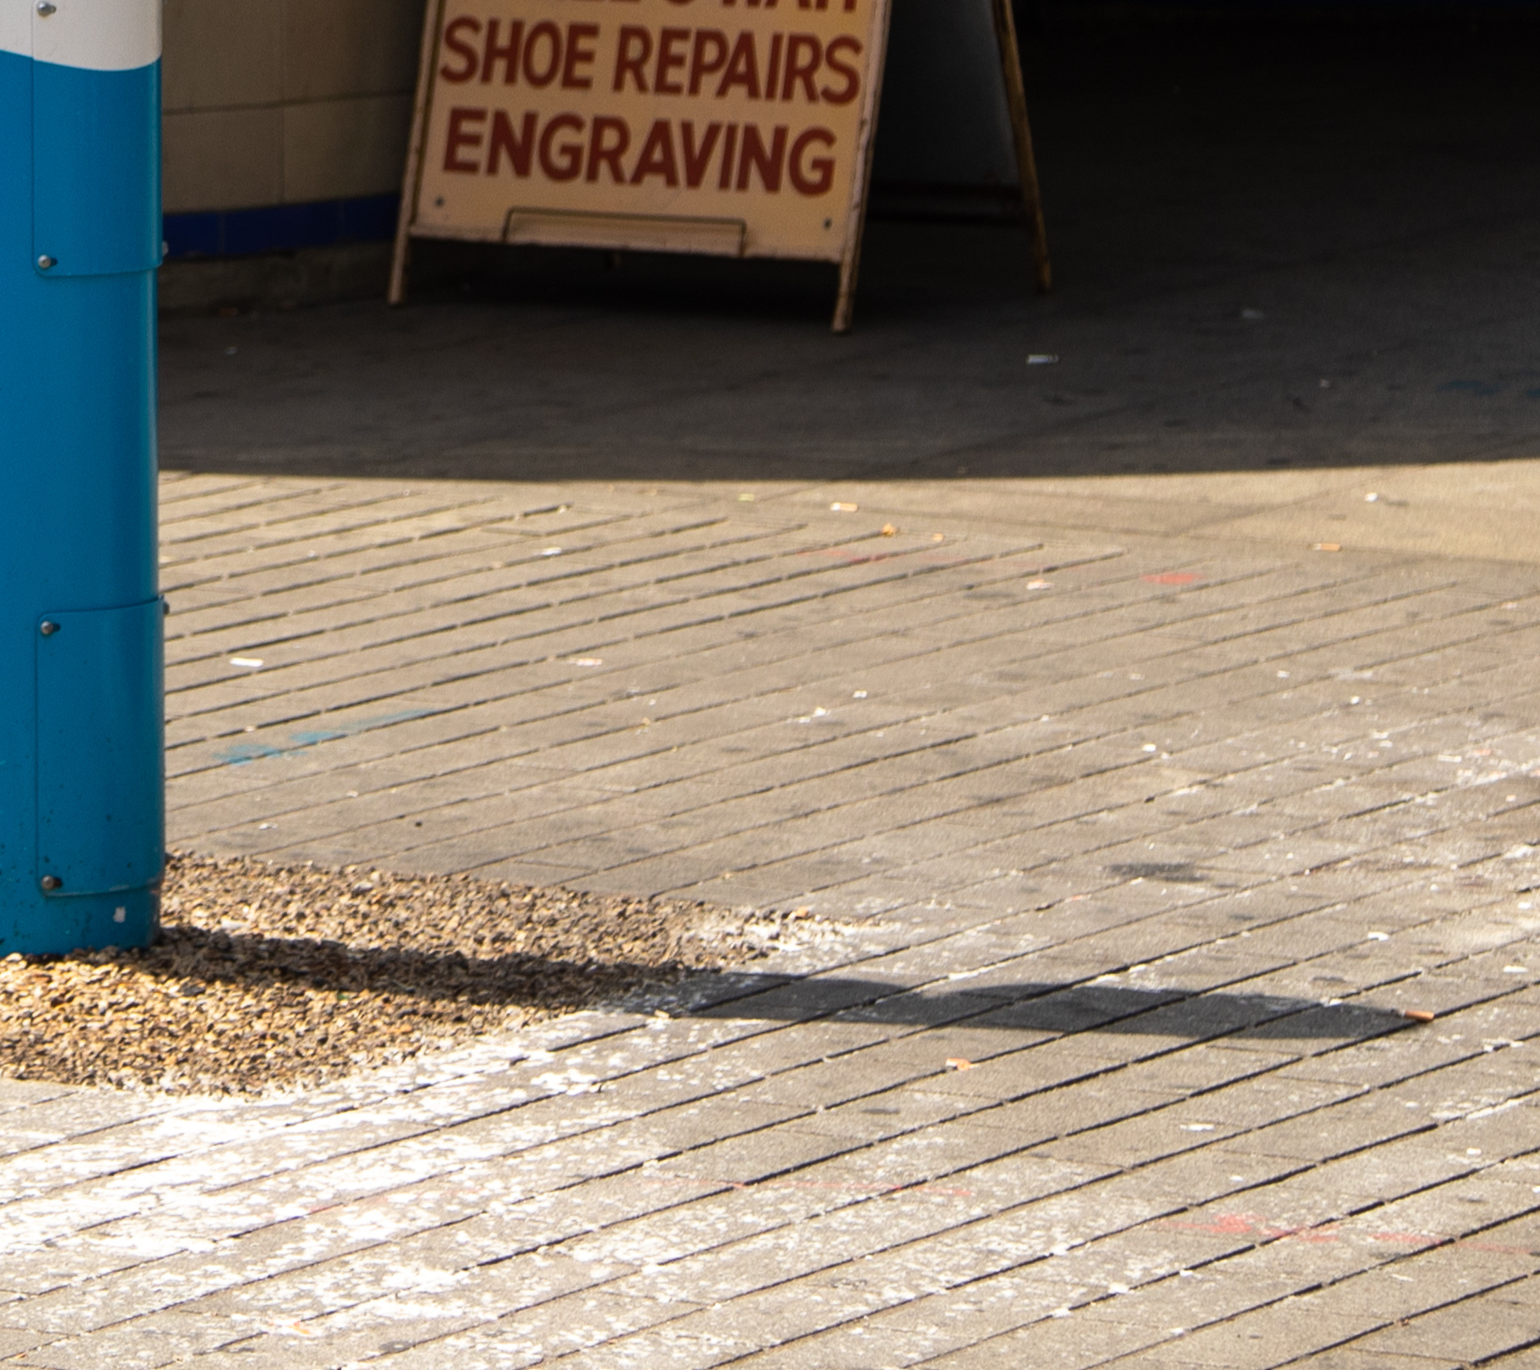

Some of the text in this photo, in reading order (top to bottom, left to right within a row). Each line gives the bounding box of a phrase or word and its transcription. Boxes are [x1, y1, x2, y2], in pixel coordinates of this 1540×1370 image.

[440, 15, 863, 107] SHOE REPAIRS
[442, 107, 839, 197] ENGRAVING
